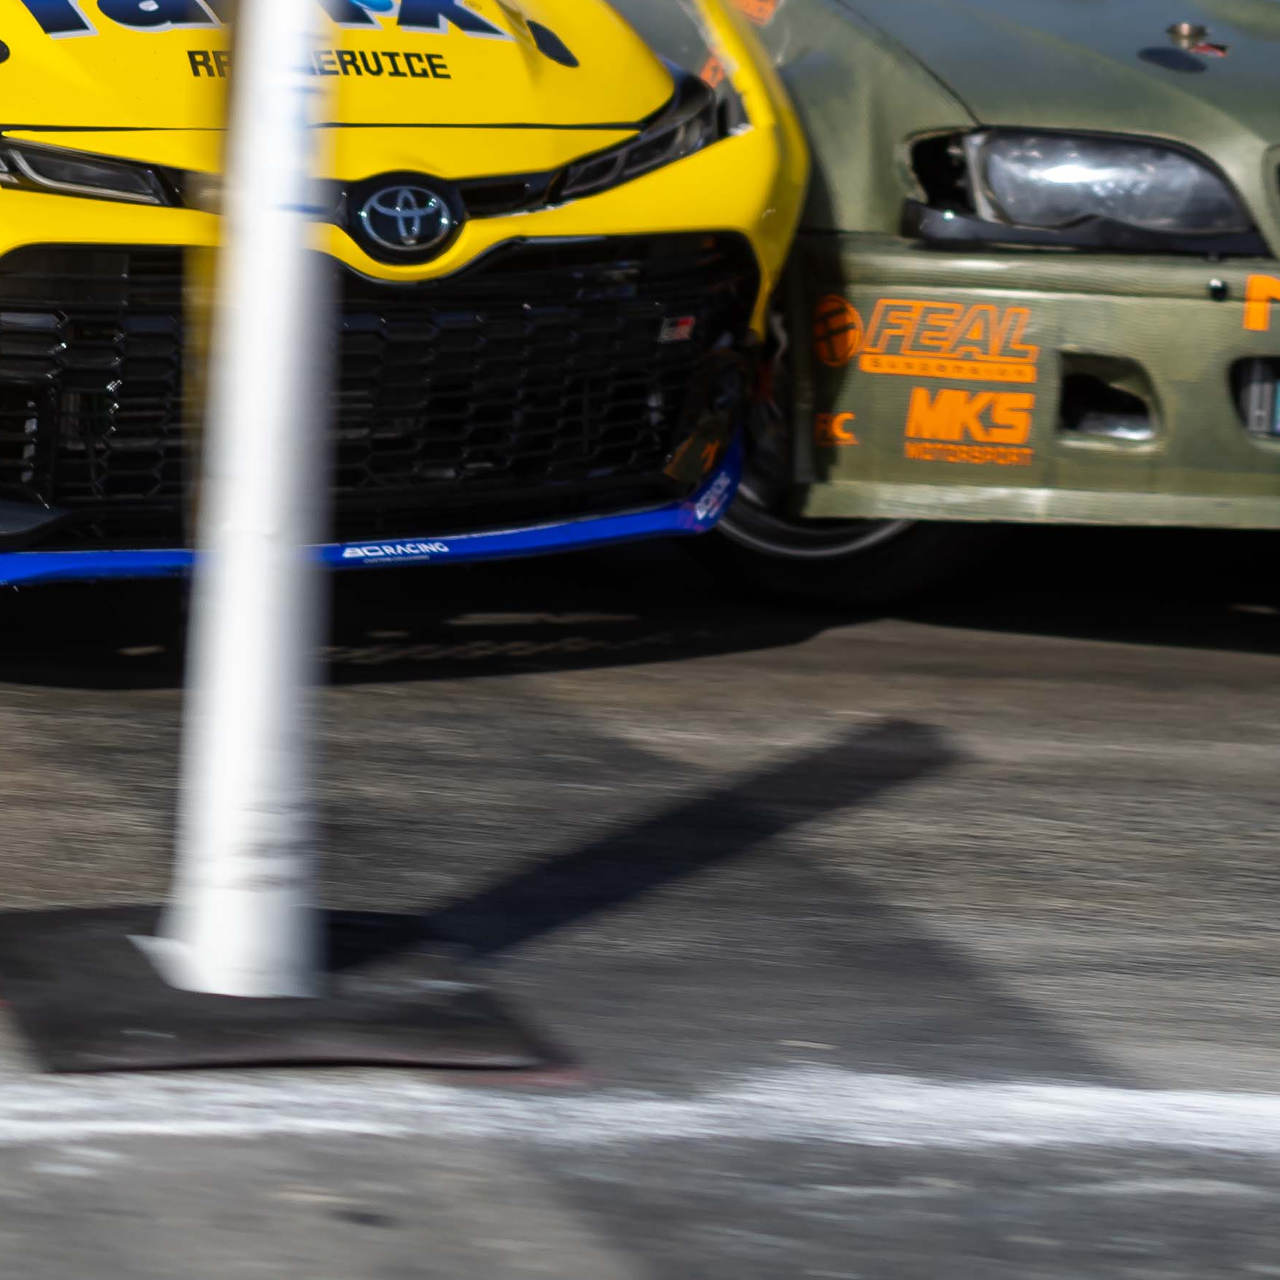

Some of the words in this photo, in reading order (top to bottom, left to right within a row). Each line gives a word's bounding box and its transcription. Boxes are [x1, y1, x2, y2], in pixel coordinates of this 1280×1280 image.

[305, 49, 452, 80] ERVICE
[863, 298, 1040, 363] FEAL
[904, 386, 1036, 445] MKS
[381, 542, 450, 556] RACING
